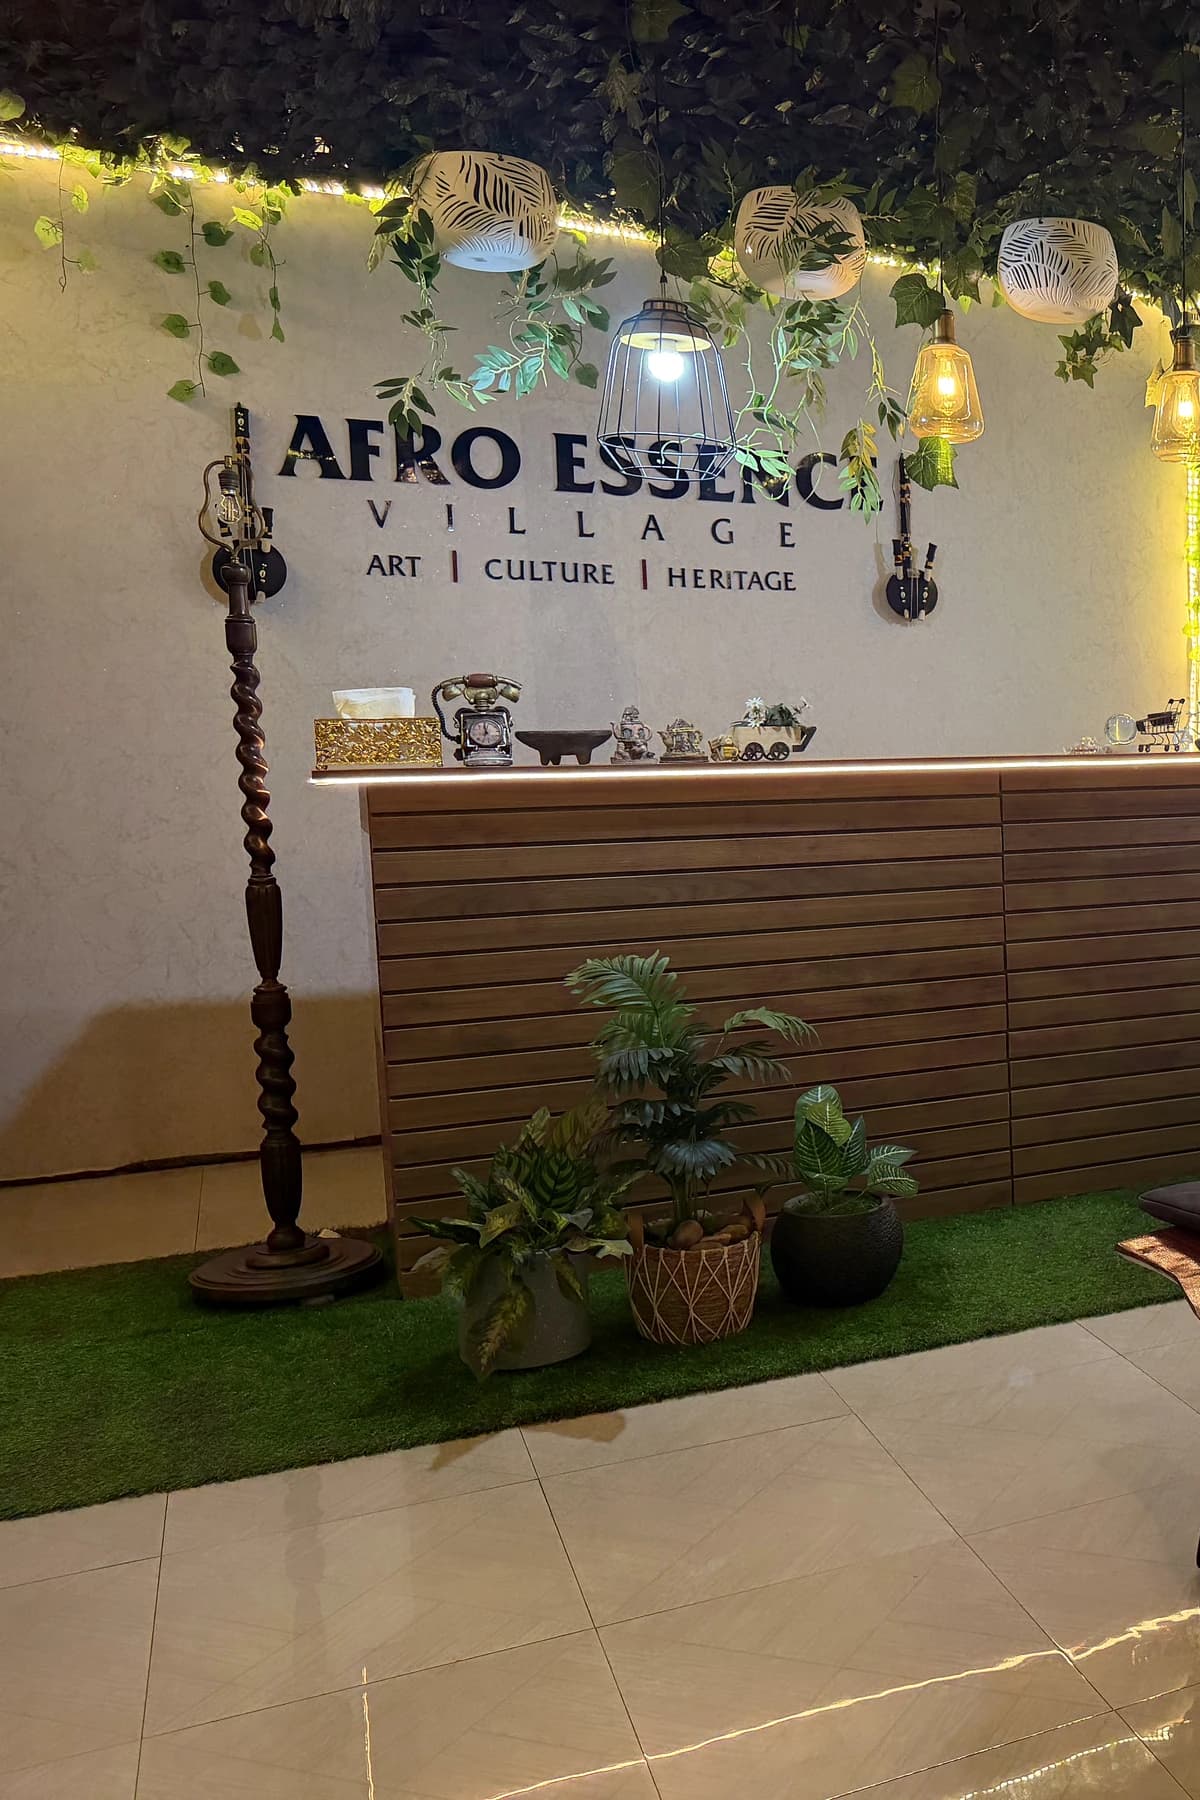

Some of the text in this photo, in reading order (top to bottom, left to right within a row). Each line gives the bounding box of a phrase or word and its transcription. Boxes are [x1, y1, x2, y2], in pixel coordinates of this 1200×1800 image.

[278, 415, 521, 490] AFRO
[366, 500, 796, 548] VILLAGE
[366, 554, 797, 592] ART CULTURE HERITAGE
